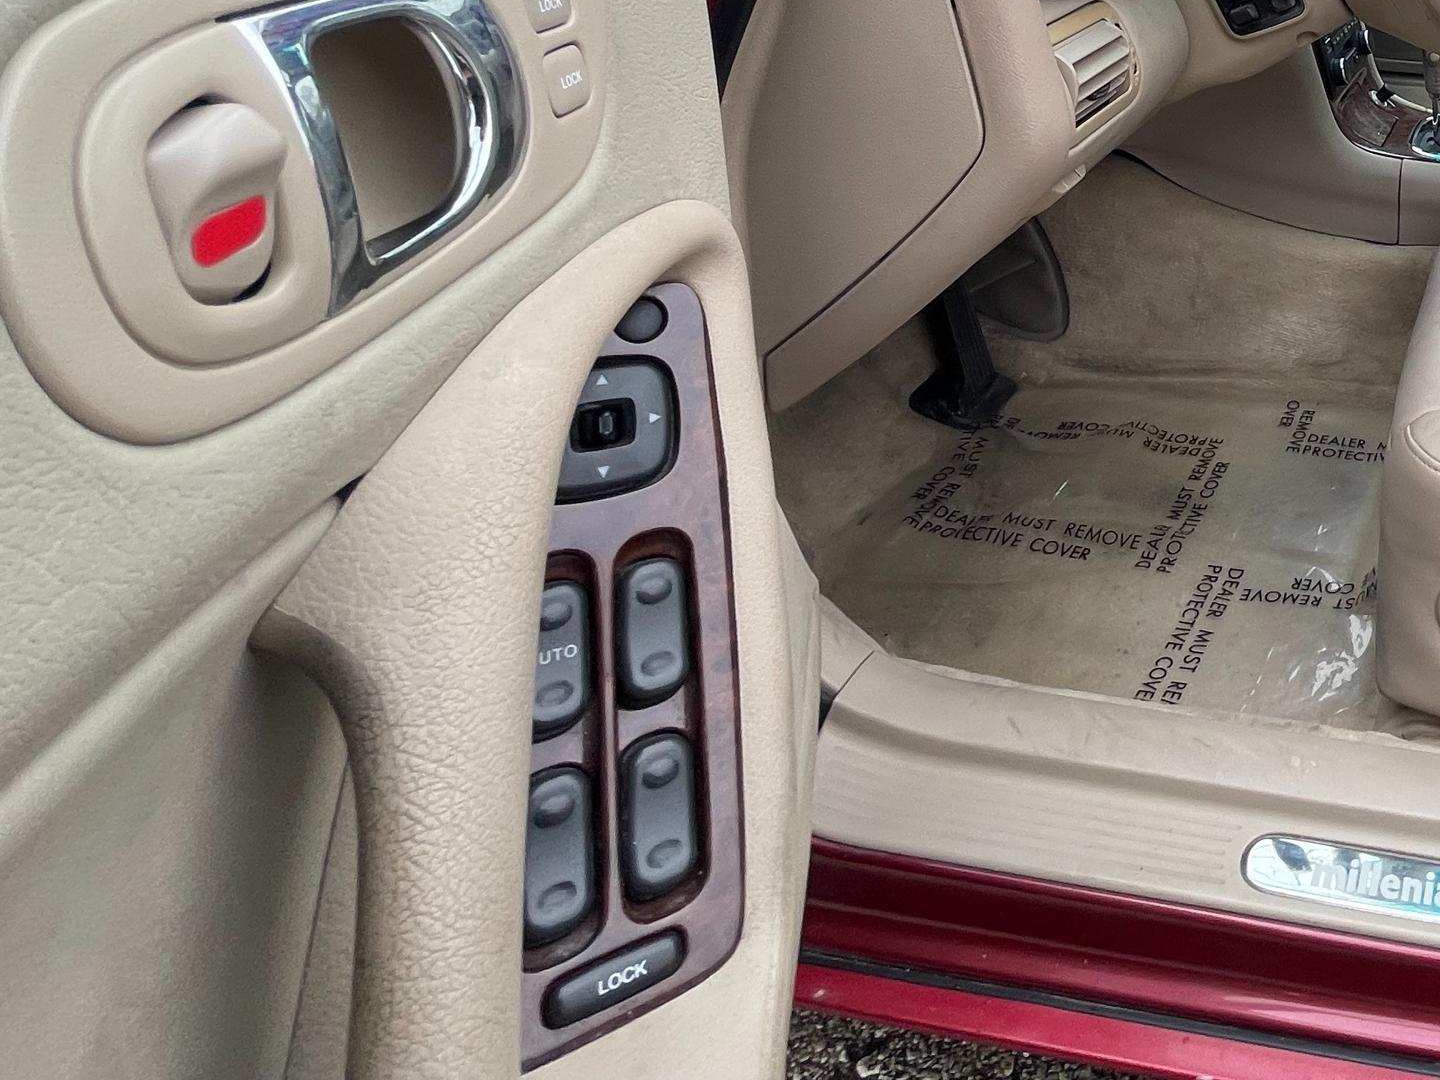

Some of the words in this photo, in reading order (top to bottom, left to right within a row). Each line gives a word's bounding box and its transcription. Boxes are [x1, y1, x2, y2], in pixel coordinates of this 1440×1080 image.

[560, 71, 583, 90] LOCK
[1277, 400, 1300, 428] OVER
[1286, 409, 1316, 453] REMOVE
[958, 436, 989, 479] MUST
[1142, 436, 1201, 457] DEALER
[1302, 444, 1385, 463] PROTECTIV
[1307, 433, 1366, 449] DEALER
[910, 465, 955, 501] COVER
[1166, 486, 1196, 520] MUST
[1188, 438, 1224, 481] REMOVE
[1200, 461, 1231, 499] COVER
[1002, 512, 1057, 532] MUST
[1064, 522, 1143, 550] REMOVE
[1029, 537, 1091, 561] COVER
[1206, 567, 1244, 618] DEALER
[1239, 588, 1323, 608] REMOVE
[1291, 576, 1356, 595] COVER
[1164, 564, 1223, 651] PROTECTIVE
[538, 643, 578, 666] UTO
[1178, 628, 1215, 674] MUST
[1132, 656, 1174, 702] COVE
[597, 959, 648, 996] LOCK
